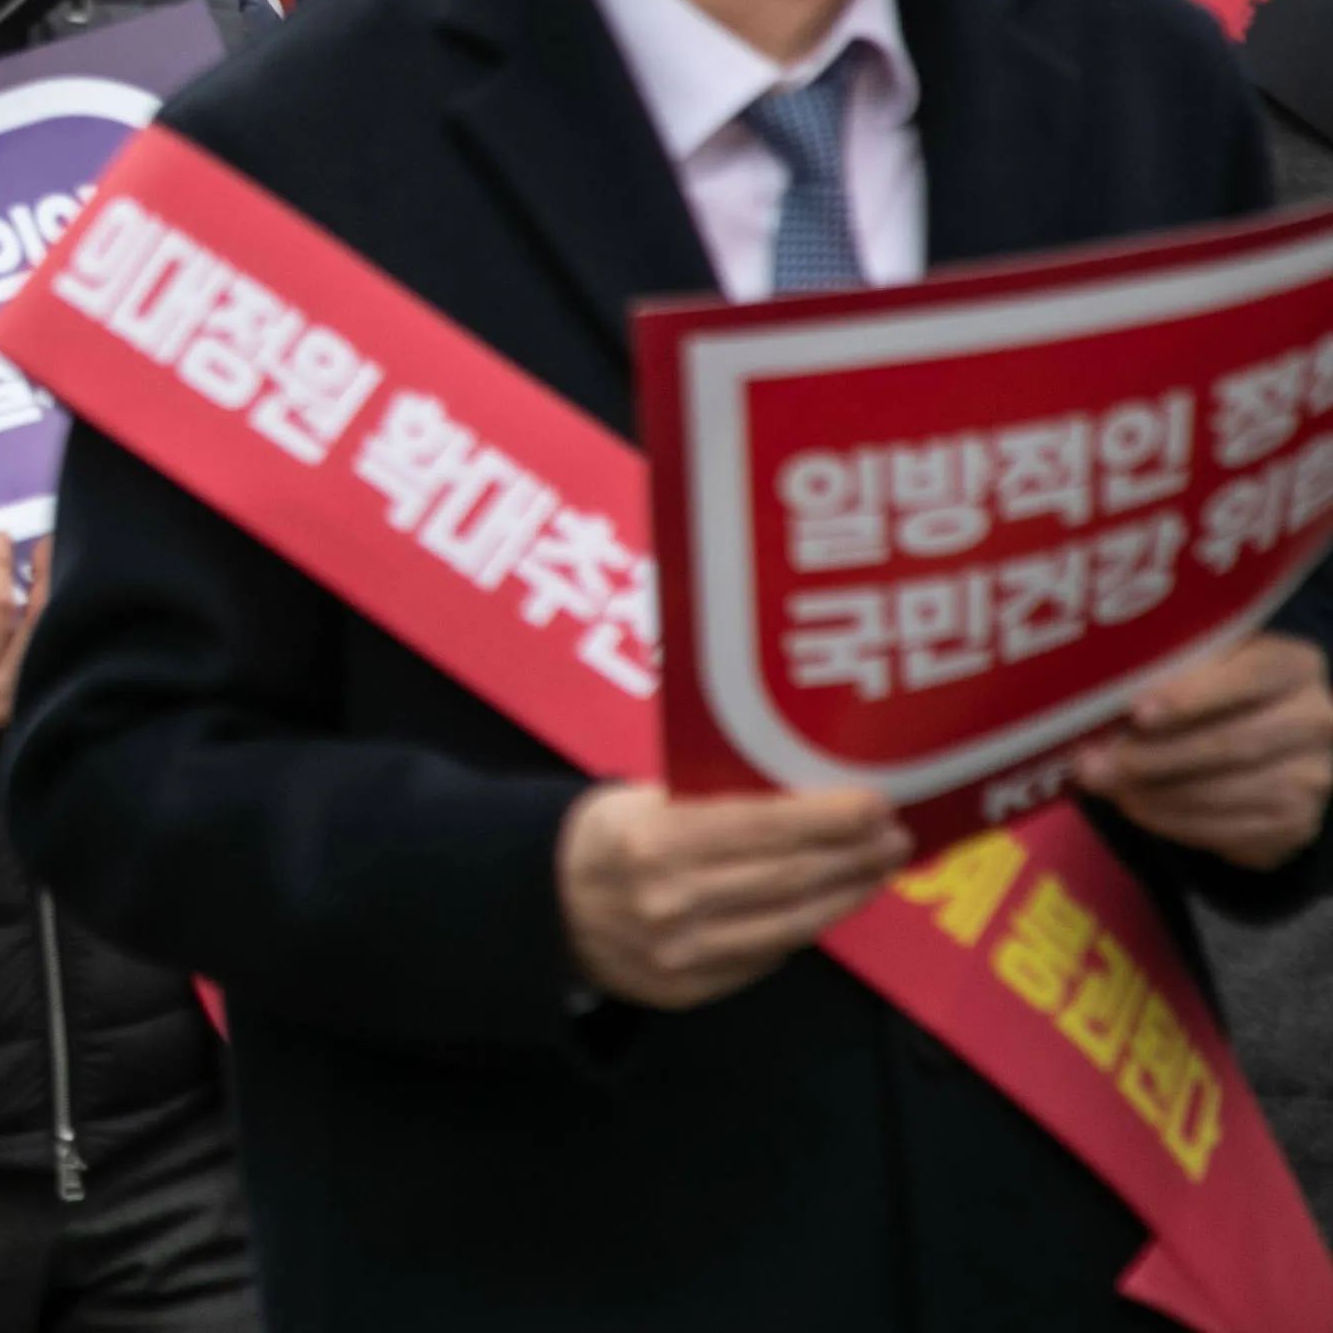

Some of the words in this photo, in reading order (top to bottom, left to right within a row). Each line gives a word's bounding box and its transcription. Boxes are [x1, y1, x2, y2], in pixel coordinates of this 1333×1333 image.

[51, 196, 384, 467] 의대정원
[777, 388, 1197, 573] 일방적인
[781, 510, 1186, 702] 국민건강
